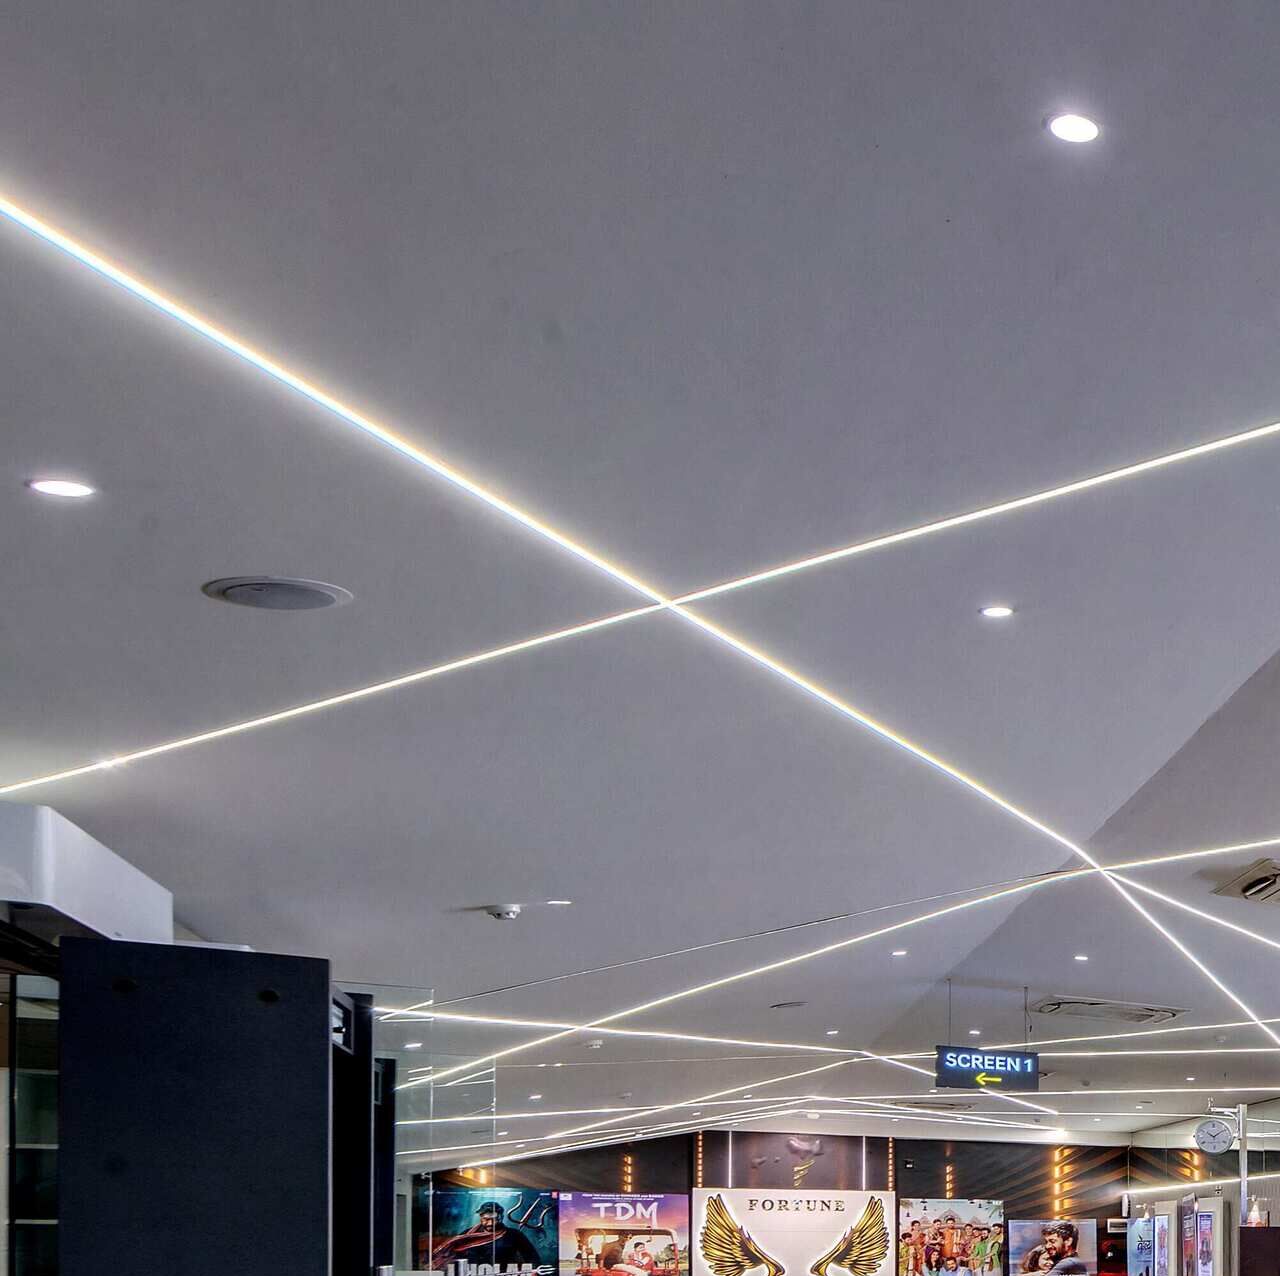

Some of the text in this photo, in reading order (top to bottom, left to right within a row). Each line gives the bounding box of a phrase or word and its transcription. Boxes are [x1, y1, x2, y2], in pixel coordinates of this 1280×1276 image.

[945, 1052, 1033, 1072] SCREEN 1
[592, 1201, 659, 1229] TDM
